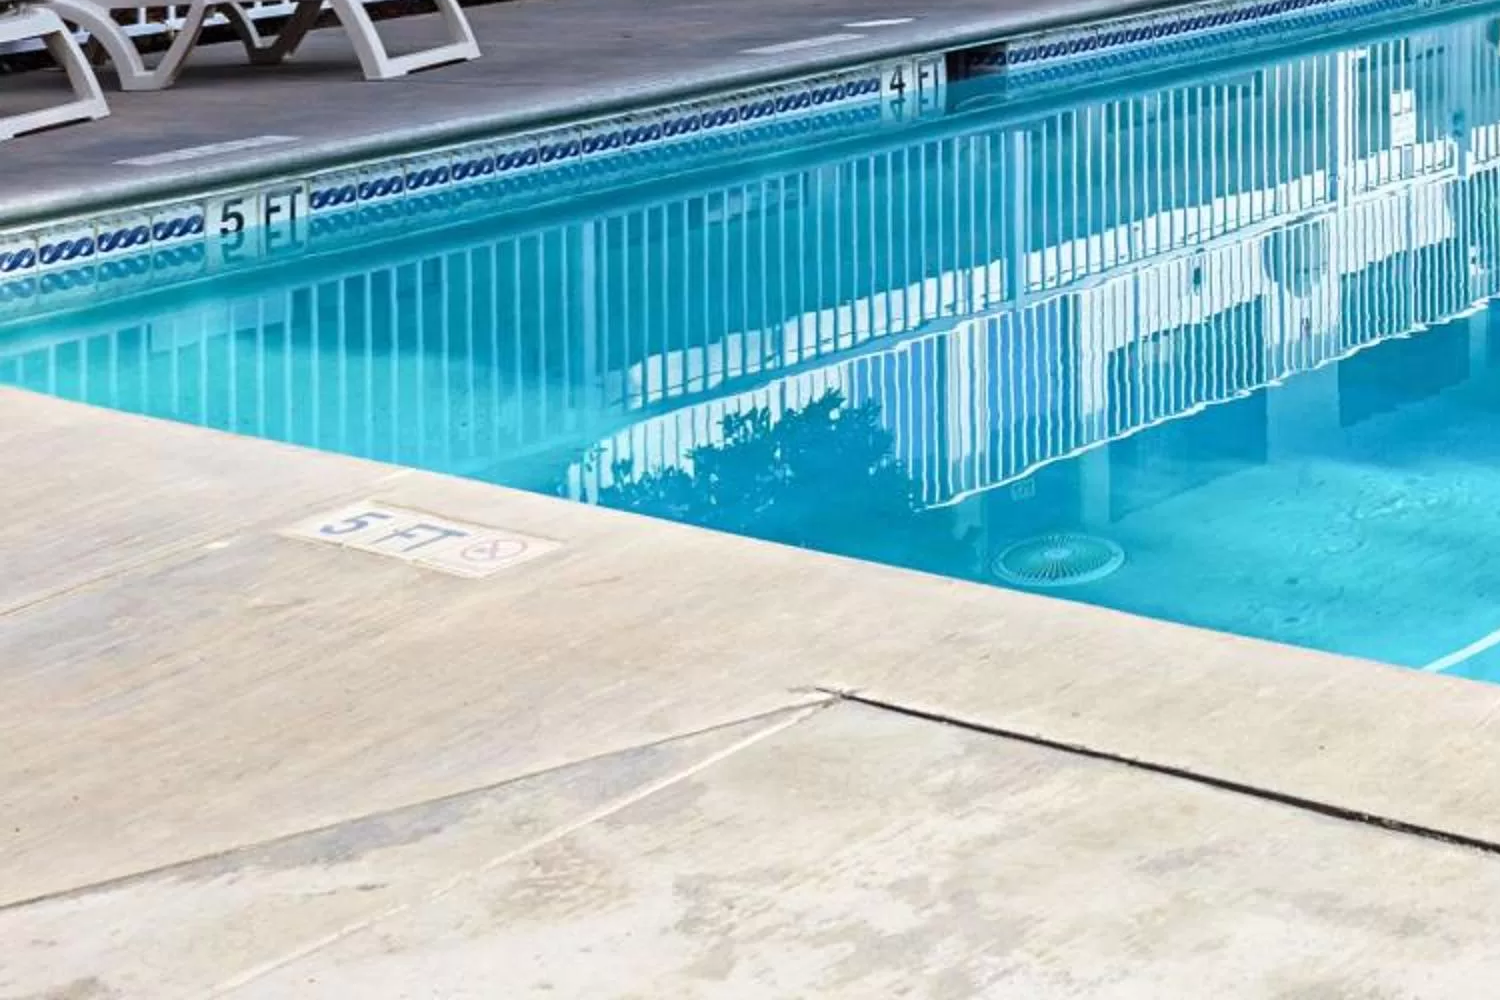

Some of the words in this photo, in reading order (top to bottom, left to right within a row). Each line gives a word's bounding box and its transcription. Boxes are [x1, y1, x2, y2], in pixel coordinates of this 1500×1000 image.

[889, 64, 906, 96] 4
[220, 198, 244, 235] 5
[265, 186, 302, 227] FT
[319, 511, 393, 535] 5
[368, 523, 469, 552] FT
